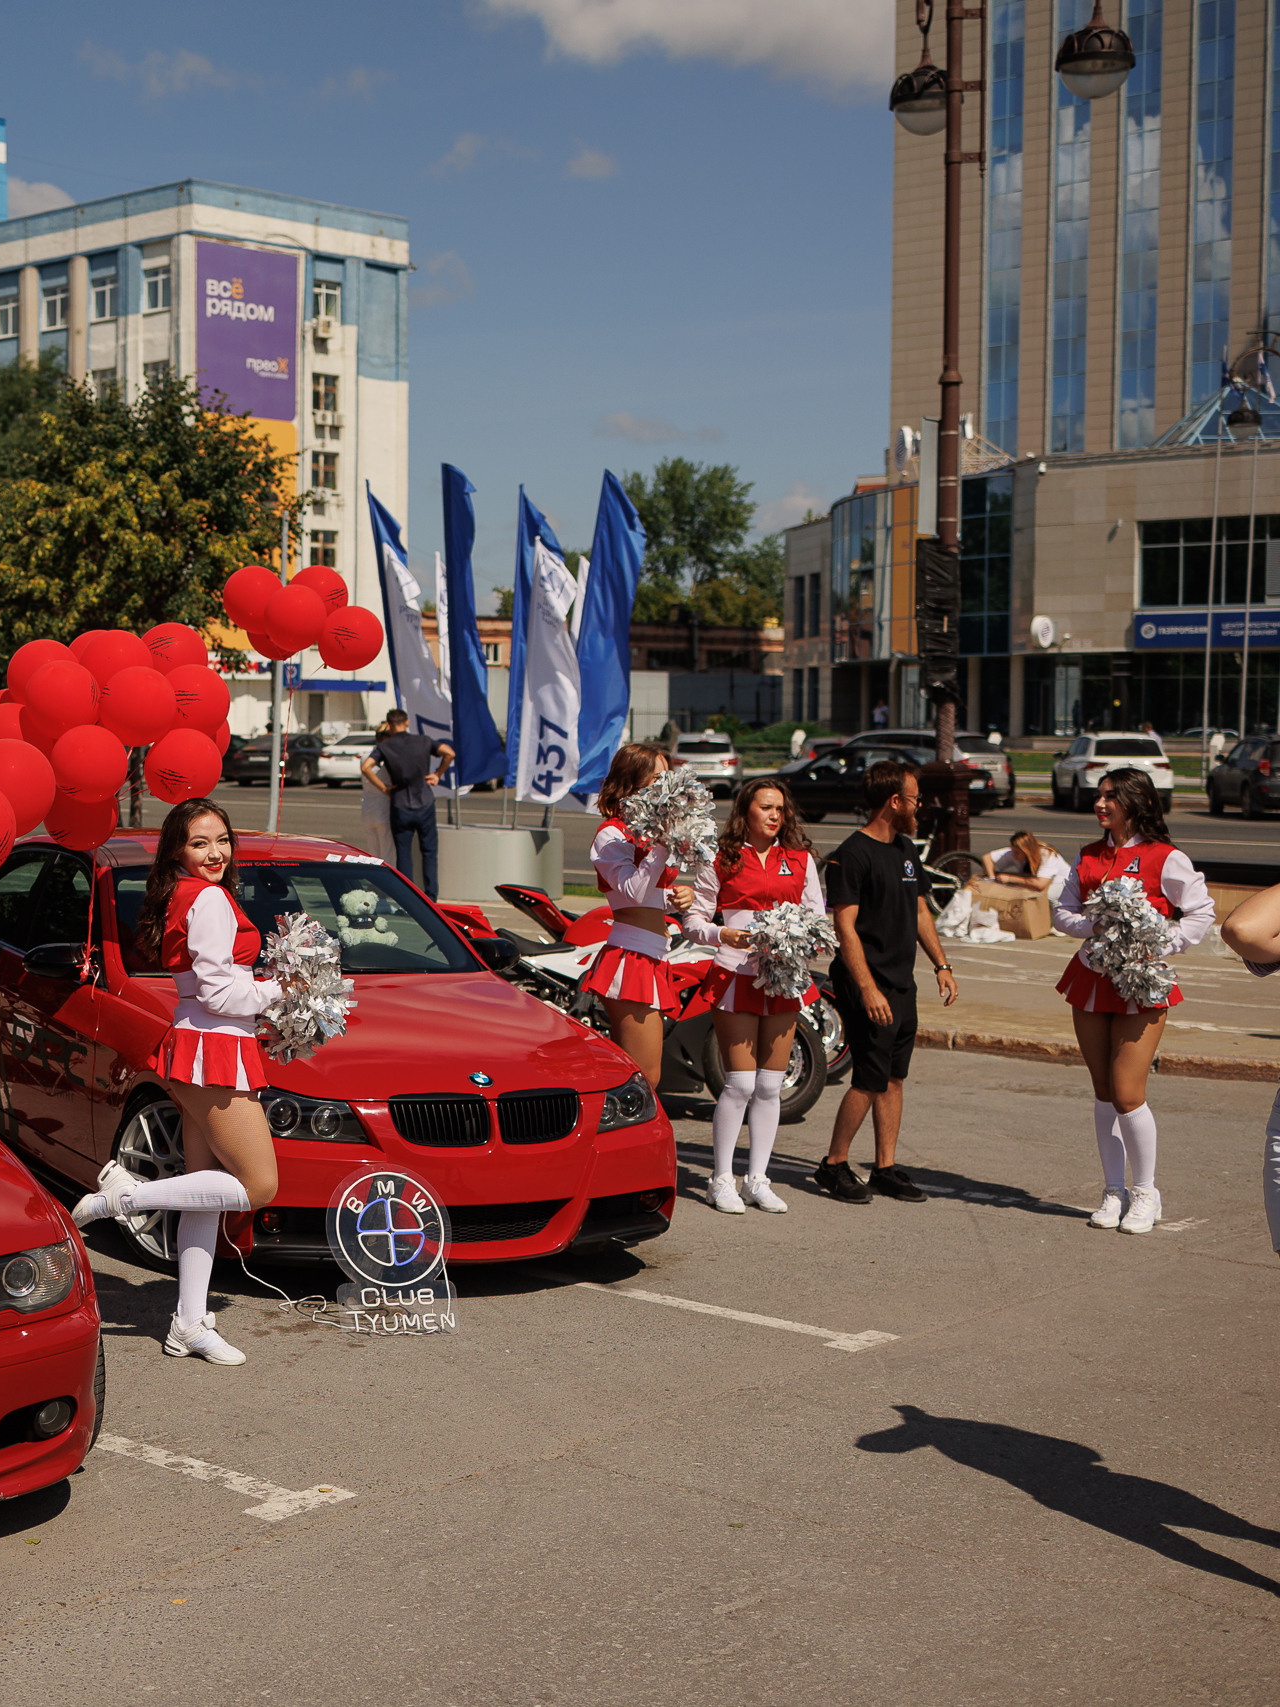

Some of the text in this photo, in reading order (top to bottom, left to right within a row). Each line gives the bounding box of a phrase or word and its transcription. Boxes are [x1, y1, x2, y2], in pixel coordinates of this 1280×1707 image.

[205, 277, 244, 299] всё
[205, 297, 275, 323] рядом
[532, 714, 568, 797] 437
[345, 1180, 432, 1215] BMW
[361, 1287, 435, 1308] CLUB
[345, 1311, 457, 1333] TYUMEN
